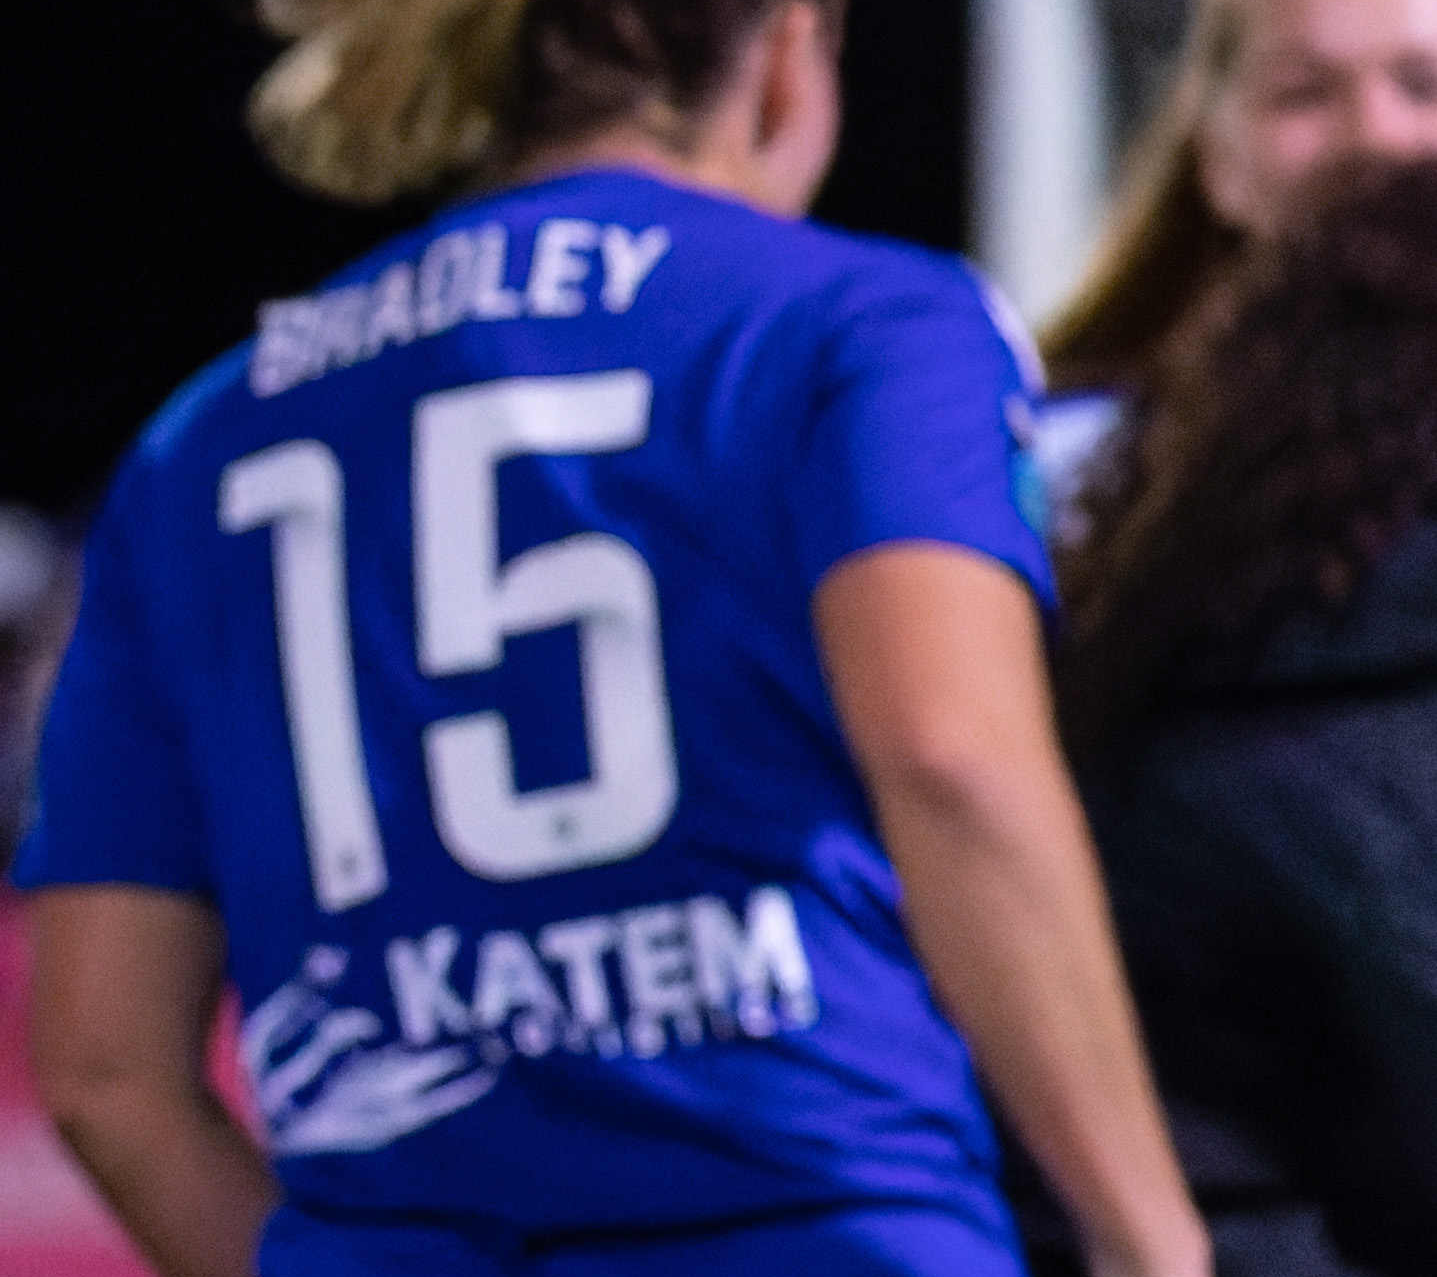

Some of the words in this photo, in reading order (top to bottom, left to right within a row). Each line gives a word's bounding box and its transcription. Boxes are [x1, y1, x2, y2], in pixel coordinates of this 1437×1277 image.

[248, 217, 673, 400] BRADLEY
[217, 368, 679, 914] 15
[384, 885, 820, 1044] KATEM
